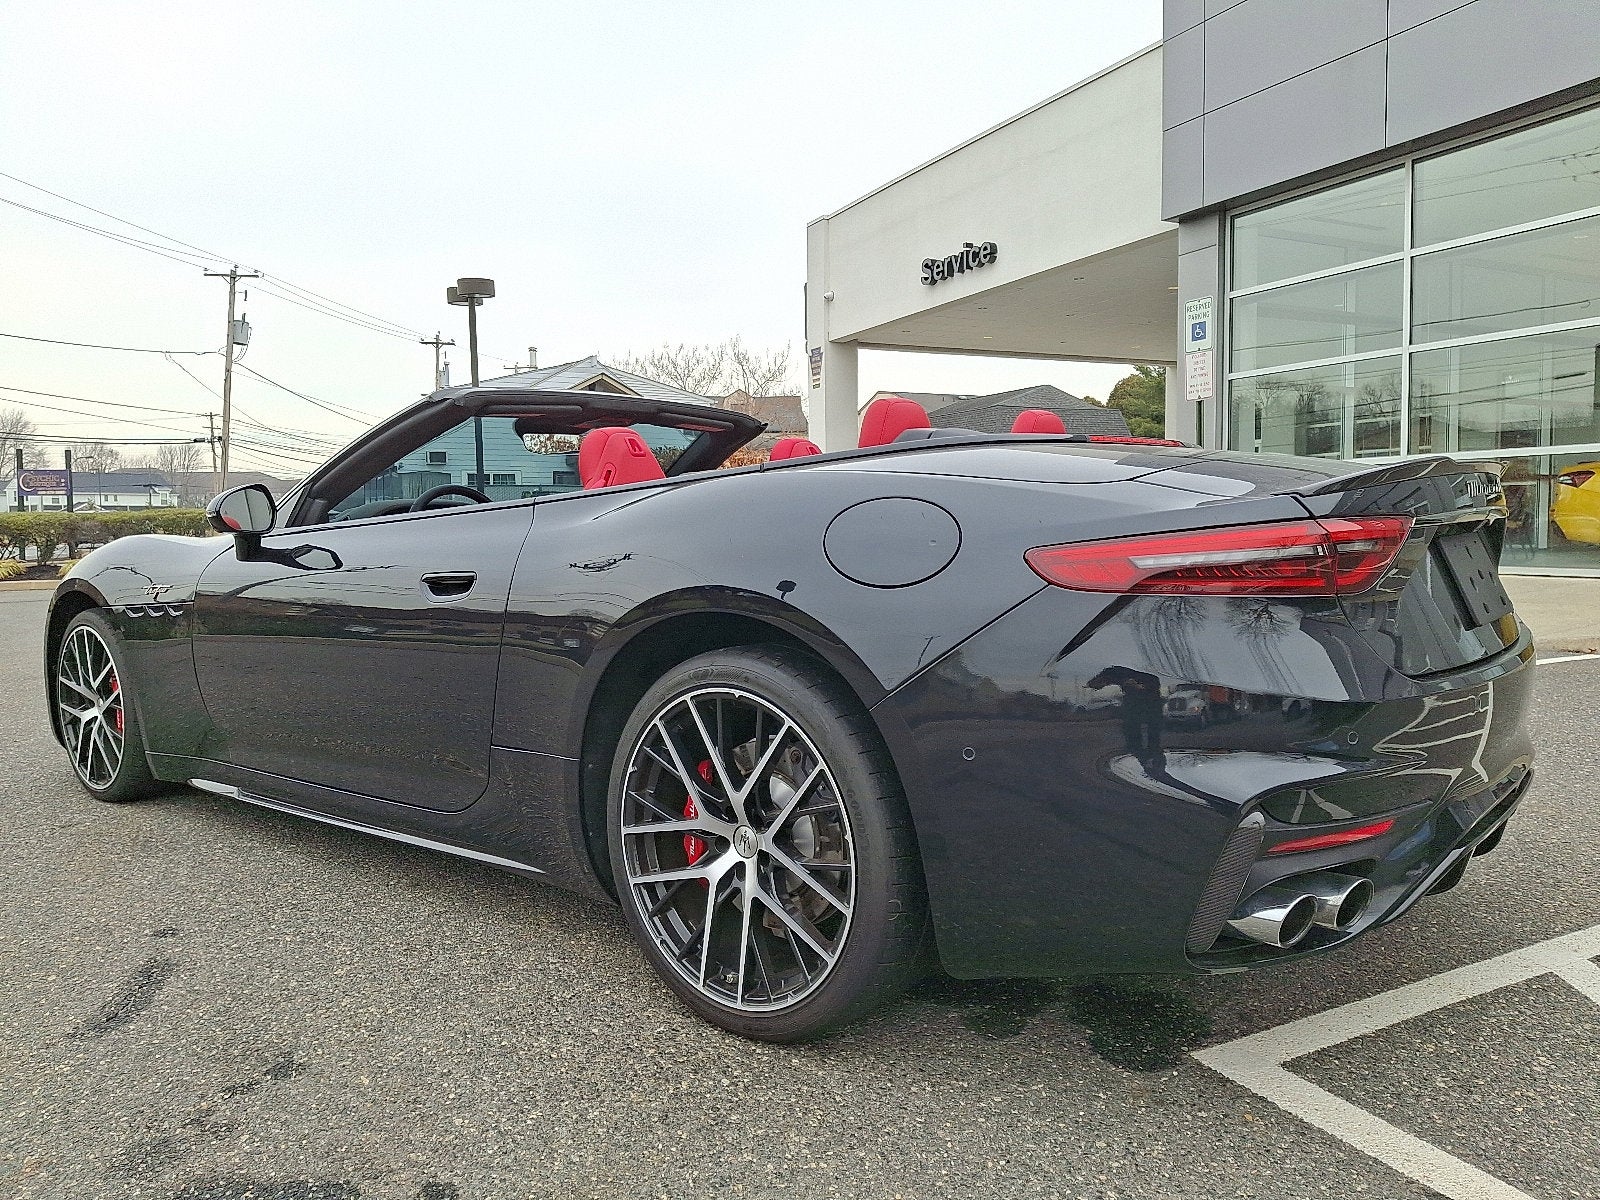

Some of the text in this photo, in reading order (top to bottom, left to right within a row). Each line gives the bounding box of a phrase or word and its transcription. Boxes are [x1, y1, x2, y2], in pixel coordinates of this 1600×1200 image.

[921, 242, 998, 286] Service
[1187, 301, 1211, 313] RESERVED
[1188, 311, 1210, 320] PARKING
